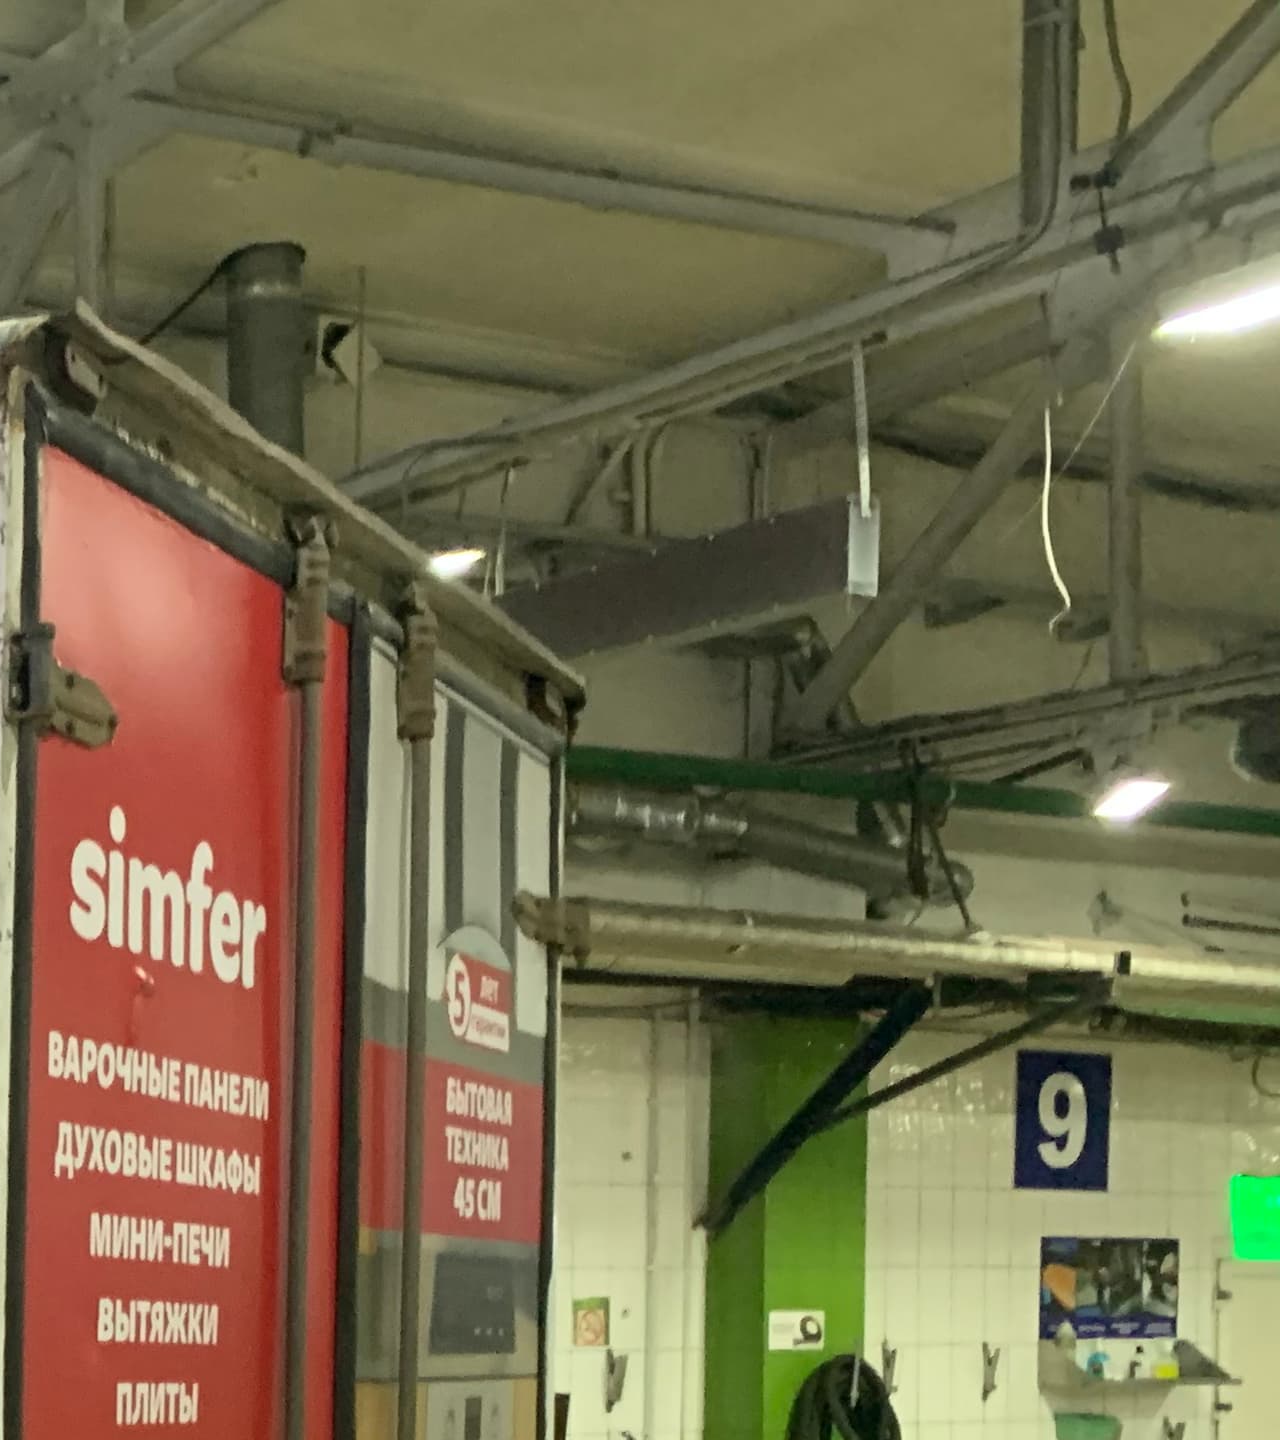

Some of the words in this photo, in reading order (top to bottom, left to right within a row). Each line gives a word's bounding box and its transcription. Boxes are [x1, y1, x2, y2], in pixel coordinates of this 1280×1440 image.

[69, 804, 267, 989] simfer
[47, 1030, 182, 1103] ВАРОЧНЫЕ
[184, 1063, 269, 1121] ПАНЕЛИ
[445, 1075, 513, 1127] БЫТОВАЯ
[1037, 1071, 1088, 1169] 9
[54, 1121, 173, 1182] ДУХОВЫЕ
[175, 1141, 261, 1196] ШКАФЫ
[444, 1125, 510, 1172] ТЕХНИКА
[453, 1175, 476, 1219] 45
[477, 1177, 502, 1223] СМ
[89, 1211, 231, 1270] МИНИ-ПЕЧИ
[96, 1297, 220, 1346] ВЫТЯЖКИ
[115, 1381, 199, 1426] ПЛИТЫ
